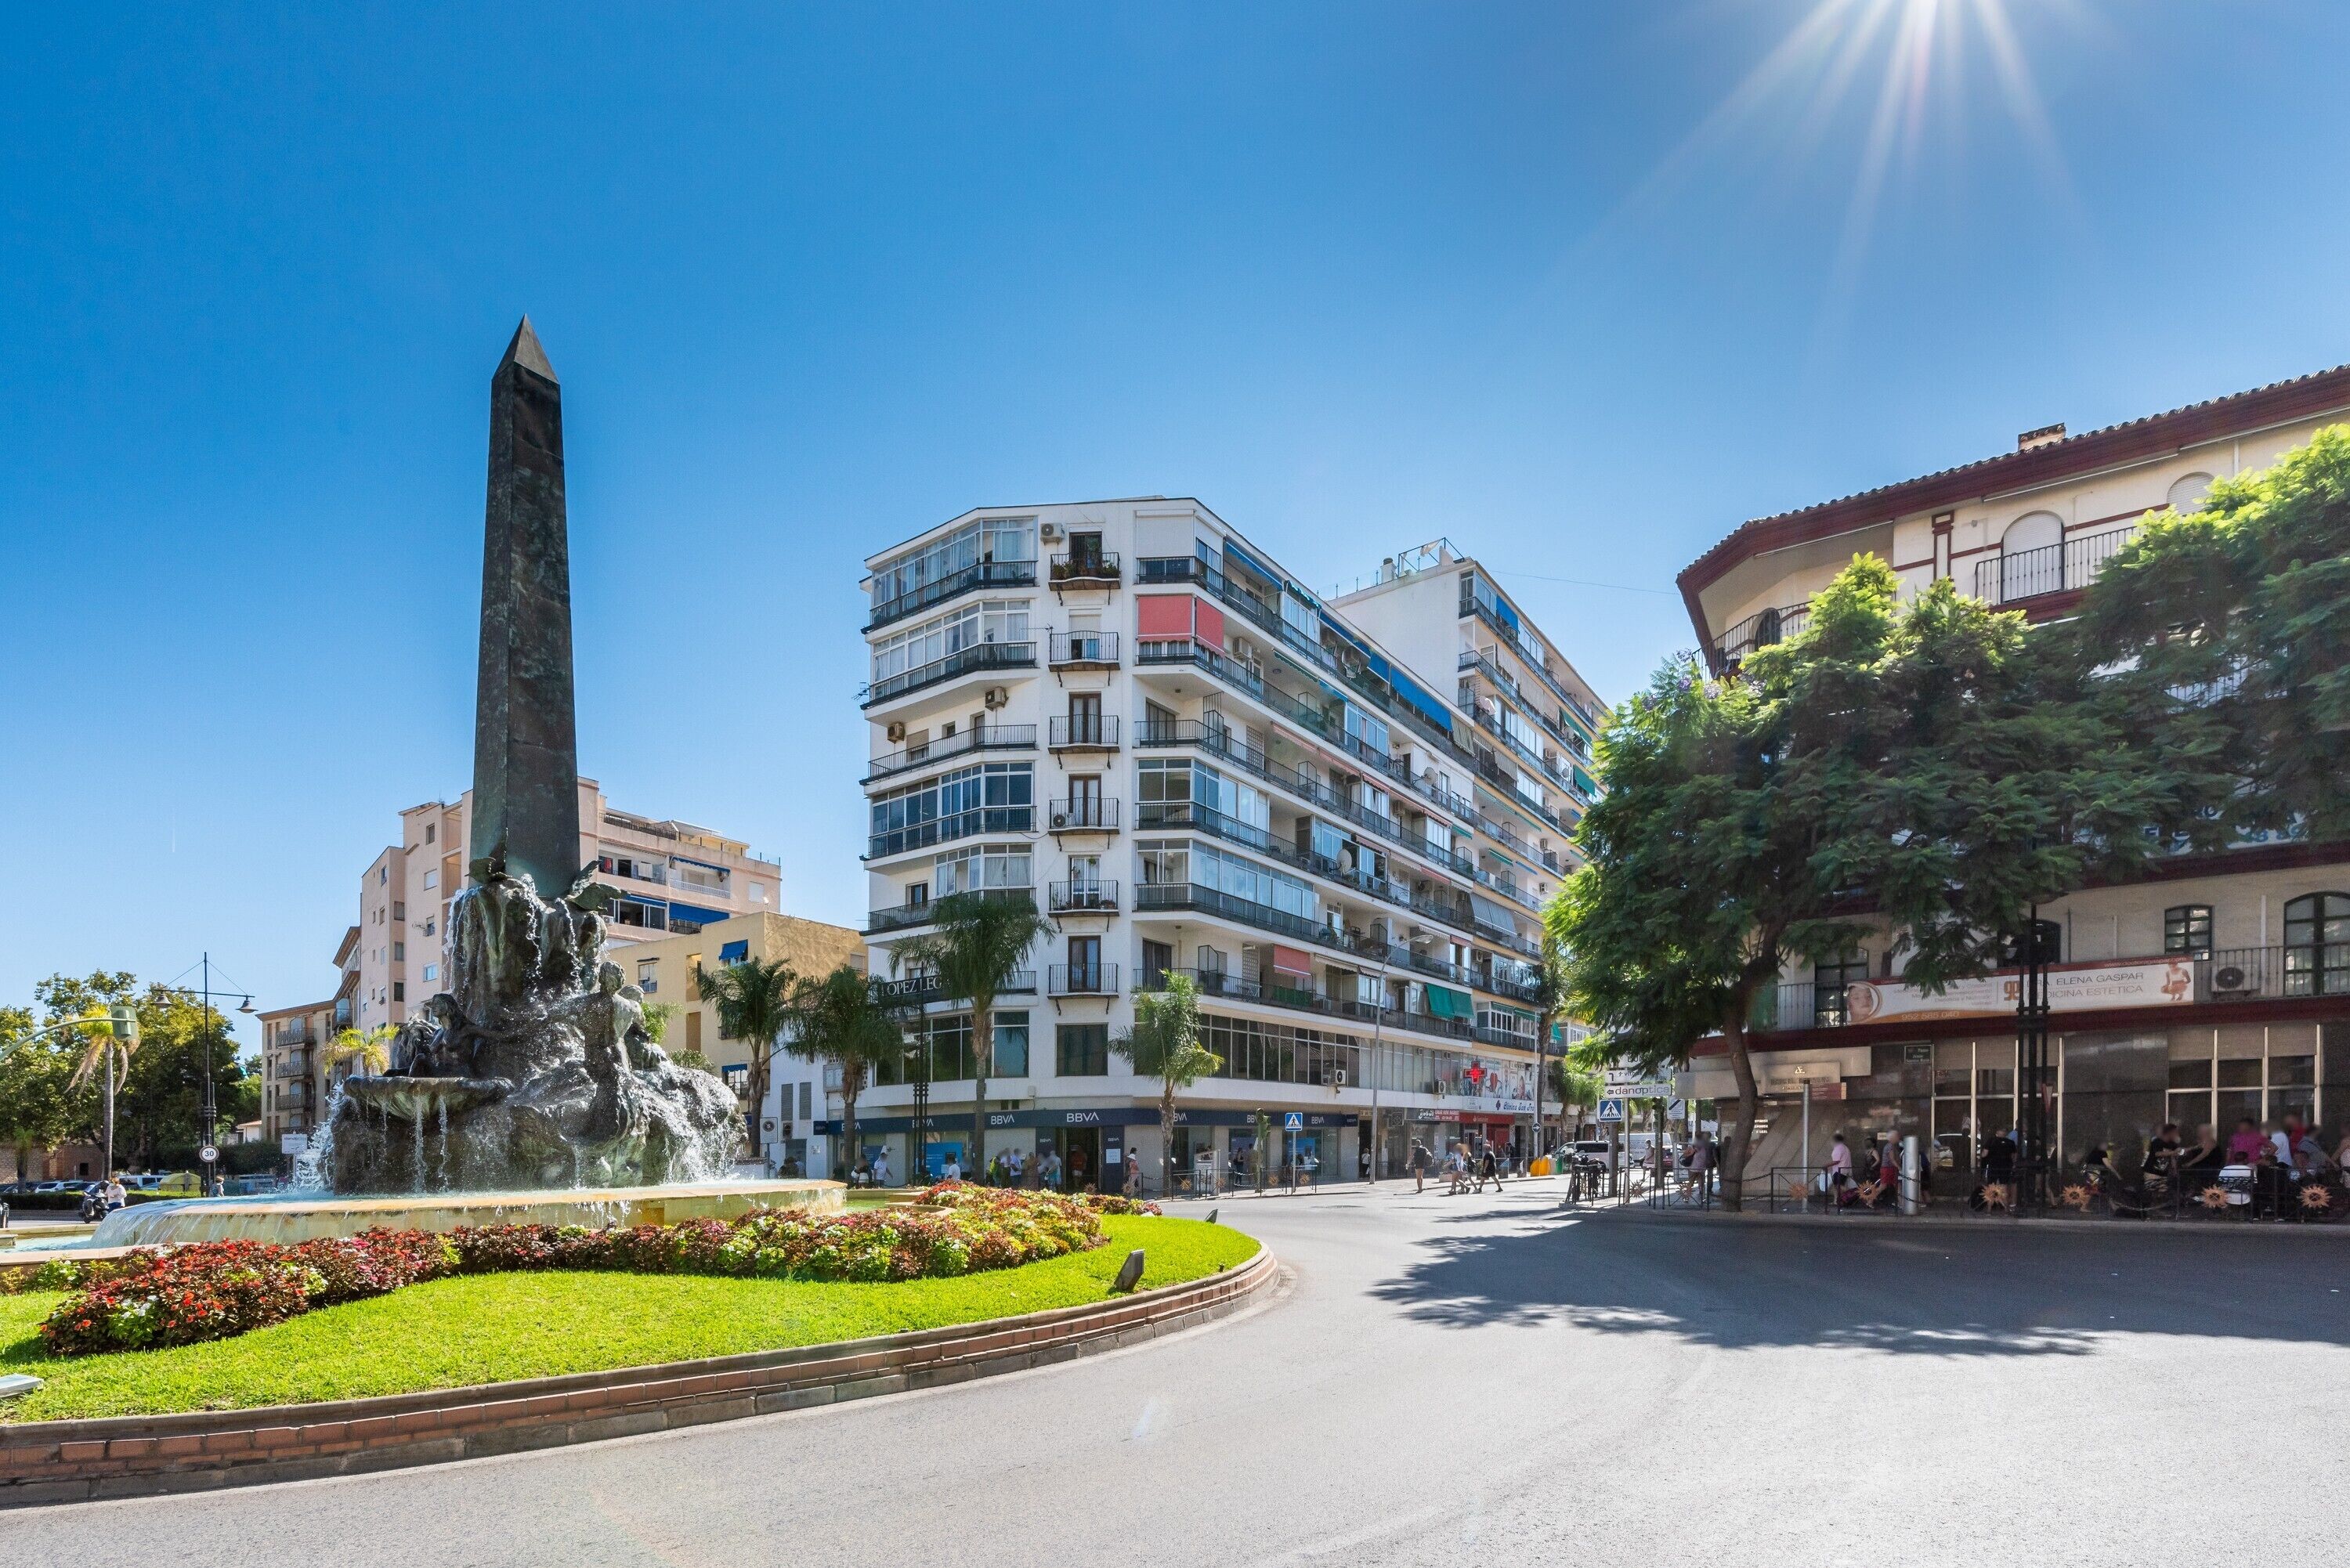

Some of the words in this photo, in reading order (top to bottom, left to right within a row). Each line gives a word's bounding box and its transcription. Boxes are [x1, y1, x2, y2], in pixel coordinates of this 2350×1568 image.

[2056, 975, 2093, 986] ELENA
[2096, 972, 2144, 983] GASPAR
[2027, 988, 2083, 999] EDICINA
[991, 1114, 1015, 1125] BBVA
[1066, 1111, 1099, 1122] BBVA
[1173, 1112, 1188, 1122] BVA
[1311, 1116, 1325, 1125] BBVA
